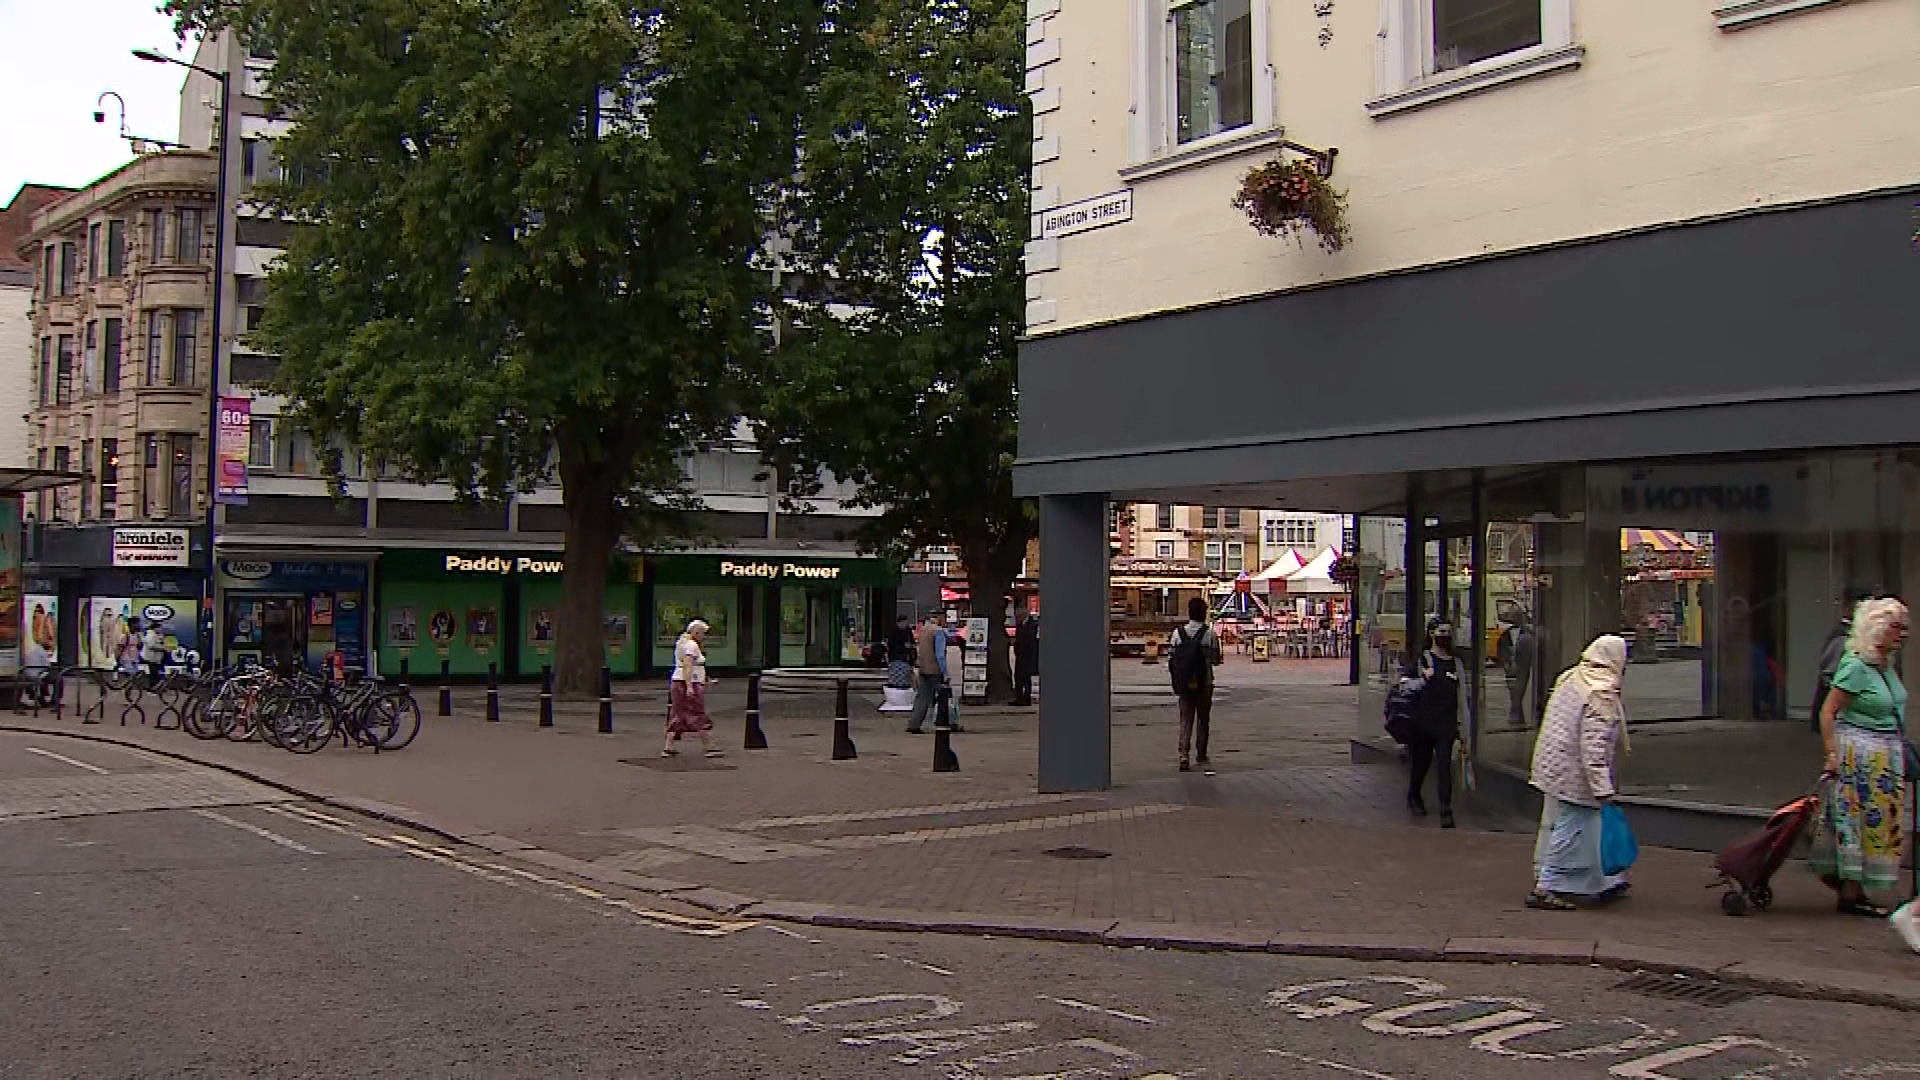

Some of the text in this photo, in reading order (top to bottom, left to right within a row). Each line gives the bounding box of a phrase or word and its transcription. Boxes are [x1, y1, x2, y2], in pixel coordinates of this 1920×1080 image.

[1045, 199, 1127, 231] ABINGTON STREET
[446, 555, 563, 575] Paddy Pow
[721, 561, 840, 580] Paddy Power
